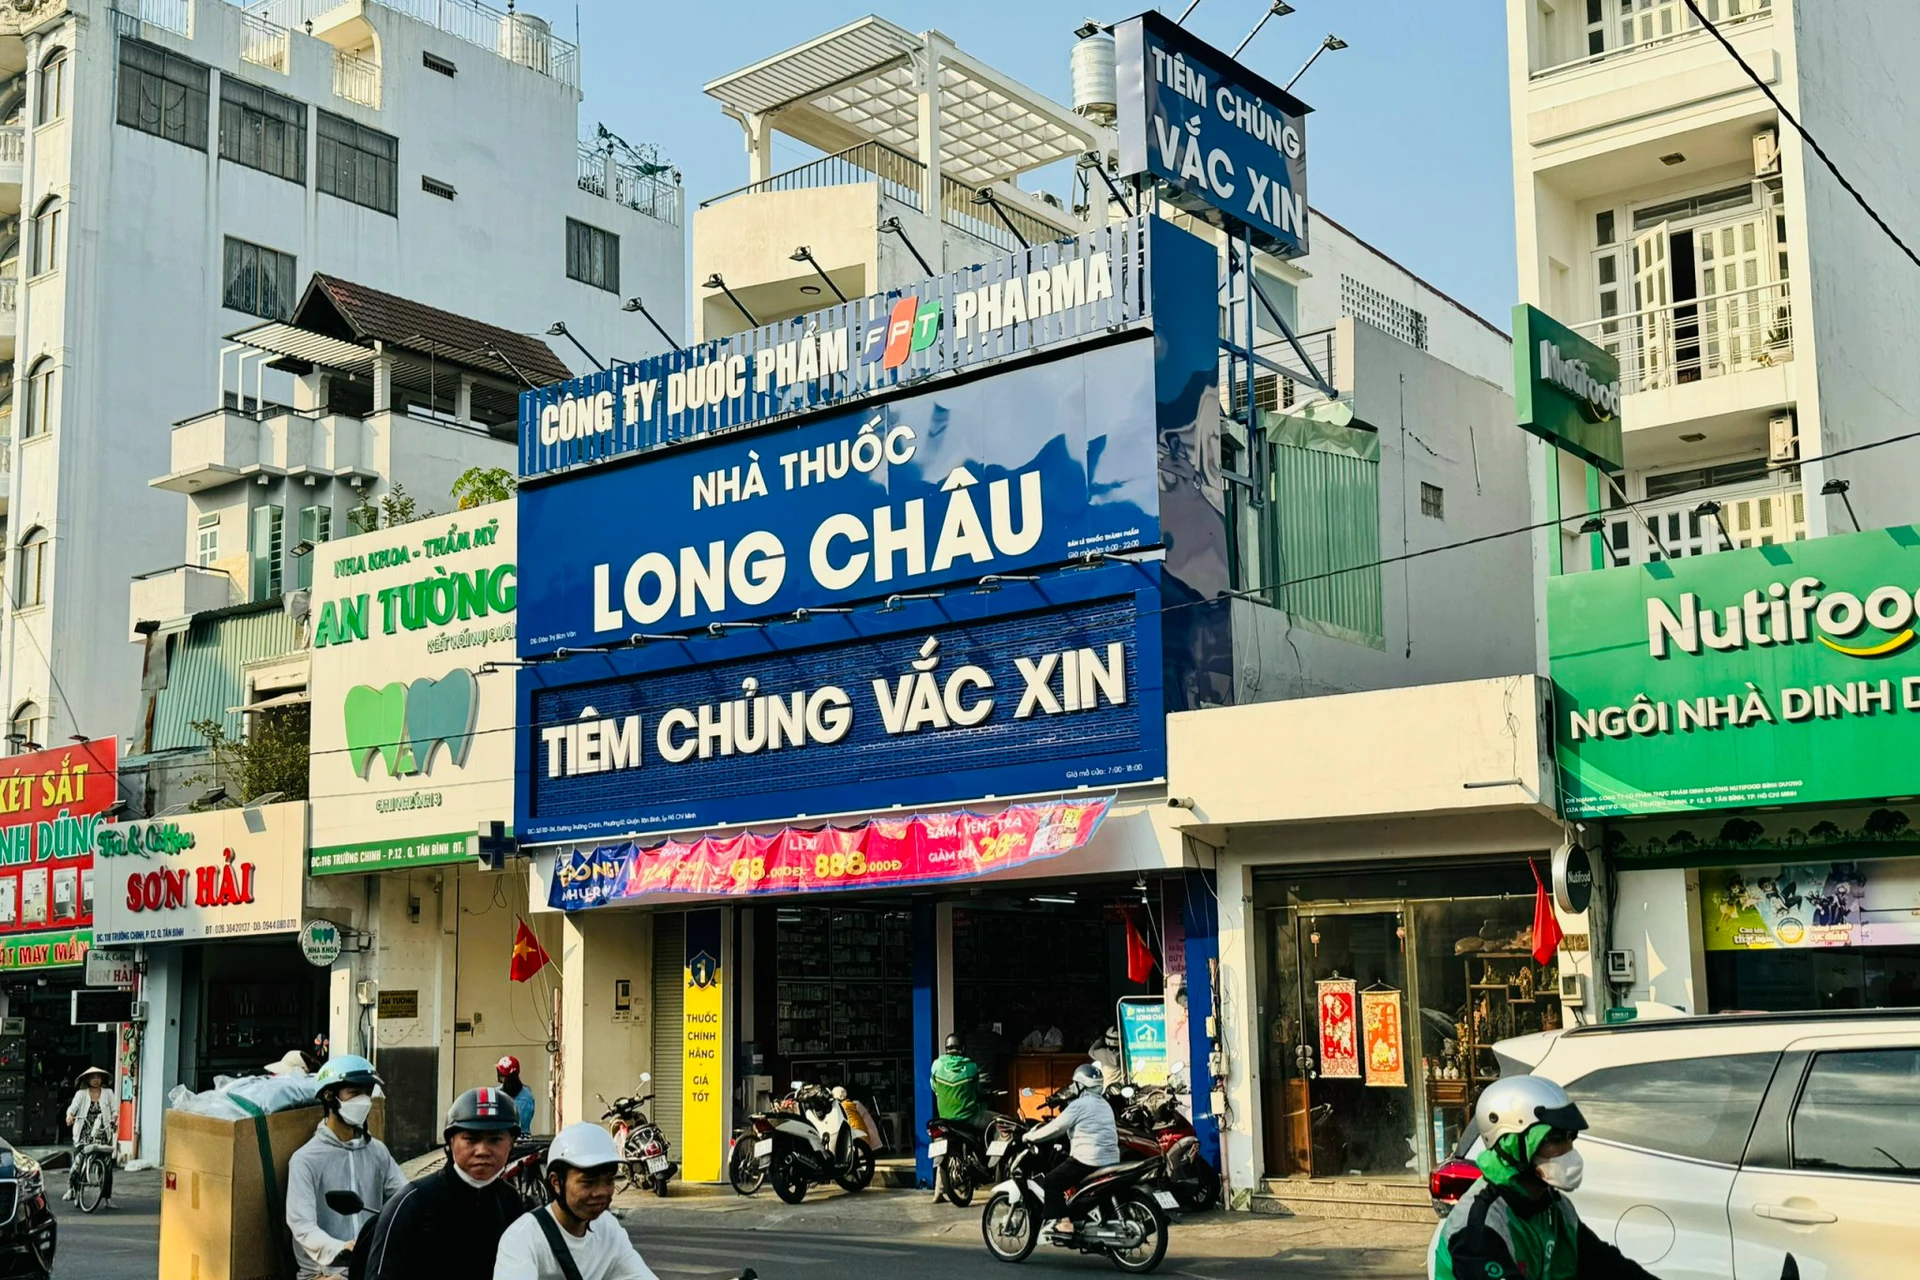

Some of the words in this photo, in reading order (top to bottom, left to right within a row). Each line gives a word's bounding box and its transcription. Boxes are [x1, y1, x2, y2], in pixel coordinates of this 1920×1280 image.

[1151, 45, 1208, 109] TIÊM
[1216, 86, 1300, 159] CHỦNG
[1154, 114, 1235, 199] VẮC
[1246, 166, 1304, 240] XIN
[541, 390, 613, 446] CÔNG
[622, 378, 659, 427] TY
[667, 352, 747, 416] DƯỢC
[757, 321, 848, 393] PHẨM
[863, 309, 938, 358] FPT
[956, 251, 1114, 340] PHARMA
[1540, 339, 1619, 417] Nutifood
[693, 450, 768, 511] NHÀ
[780, 414, 916, 491] THUỐC
[368, 545, 411, 571] KHOA
[473, 518, 499, 548] MỸ
[594, 530, 787, 633] LONG
[809, 466, 1043, 590] CHÂU
[1122, 539, 1140, 549] 22:00
[314, 593, 371, 648] AN
[1647, 576, 1920, 657] Nutifoo
[542, 705, 642, 778] TIÊM
[657, 677, 853, 763] CHỦNG
[872, 635, 995, 734] VẮC
[1013, 641, 1127, 719] XIN
[1570, 692, 1669, 740] NGÔI
[1677, 682, 1772, 729] NHÀ
[1781, 679, 1892, 720] DINH
[42, 753, 88, 807] SẮT
[1065, 770, 1078, 778] Giờ
[1126, 763, 1143, 772] 18:00
[1729, 783, 1761, 791] NUTIFOOD
[127, 824, 150, 859] &
[333, 852, 359, 866] TRƯỜNG
[360, 850, 381, 863] CHINH
[416, 843, 430, 857] TÂN
[431, 841, 449, 855] BÌNH
[979, 832, 1027, 862] 28%
[126, 864, 190, 912] SƠN
[195, 847, 256, 907] HẢI
[1568, 870, 1591, 885] Nutifood
[19, 944, 50, 965] MAY
[113, 964, 133, 982] HẢI
[686, 1010, 718, 1023] THUỐC
[687, 1028, 716, 1041] CHÍNH
[692, 1089, 710, 1102] TỐT
[693, 1073, 709, 1085] GIÁ
